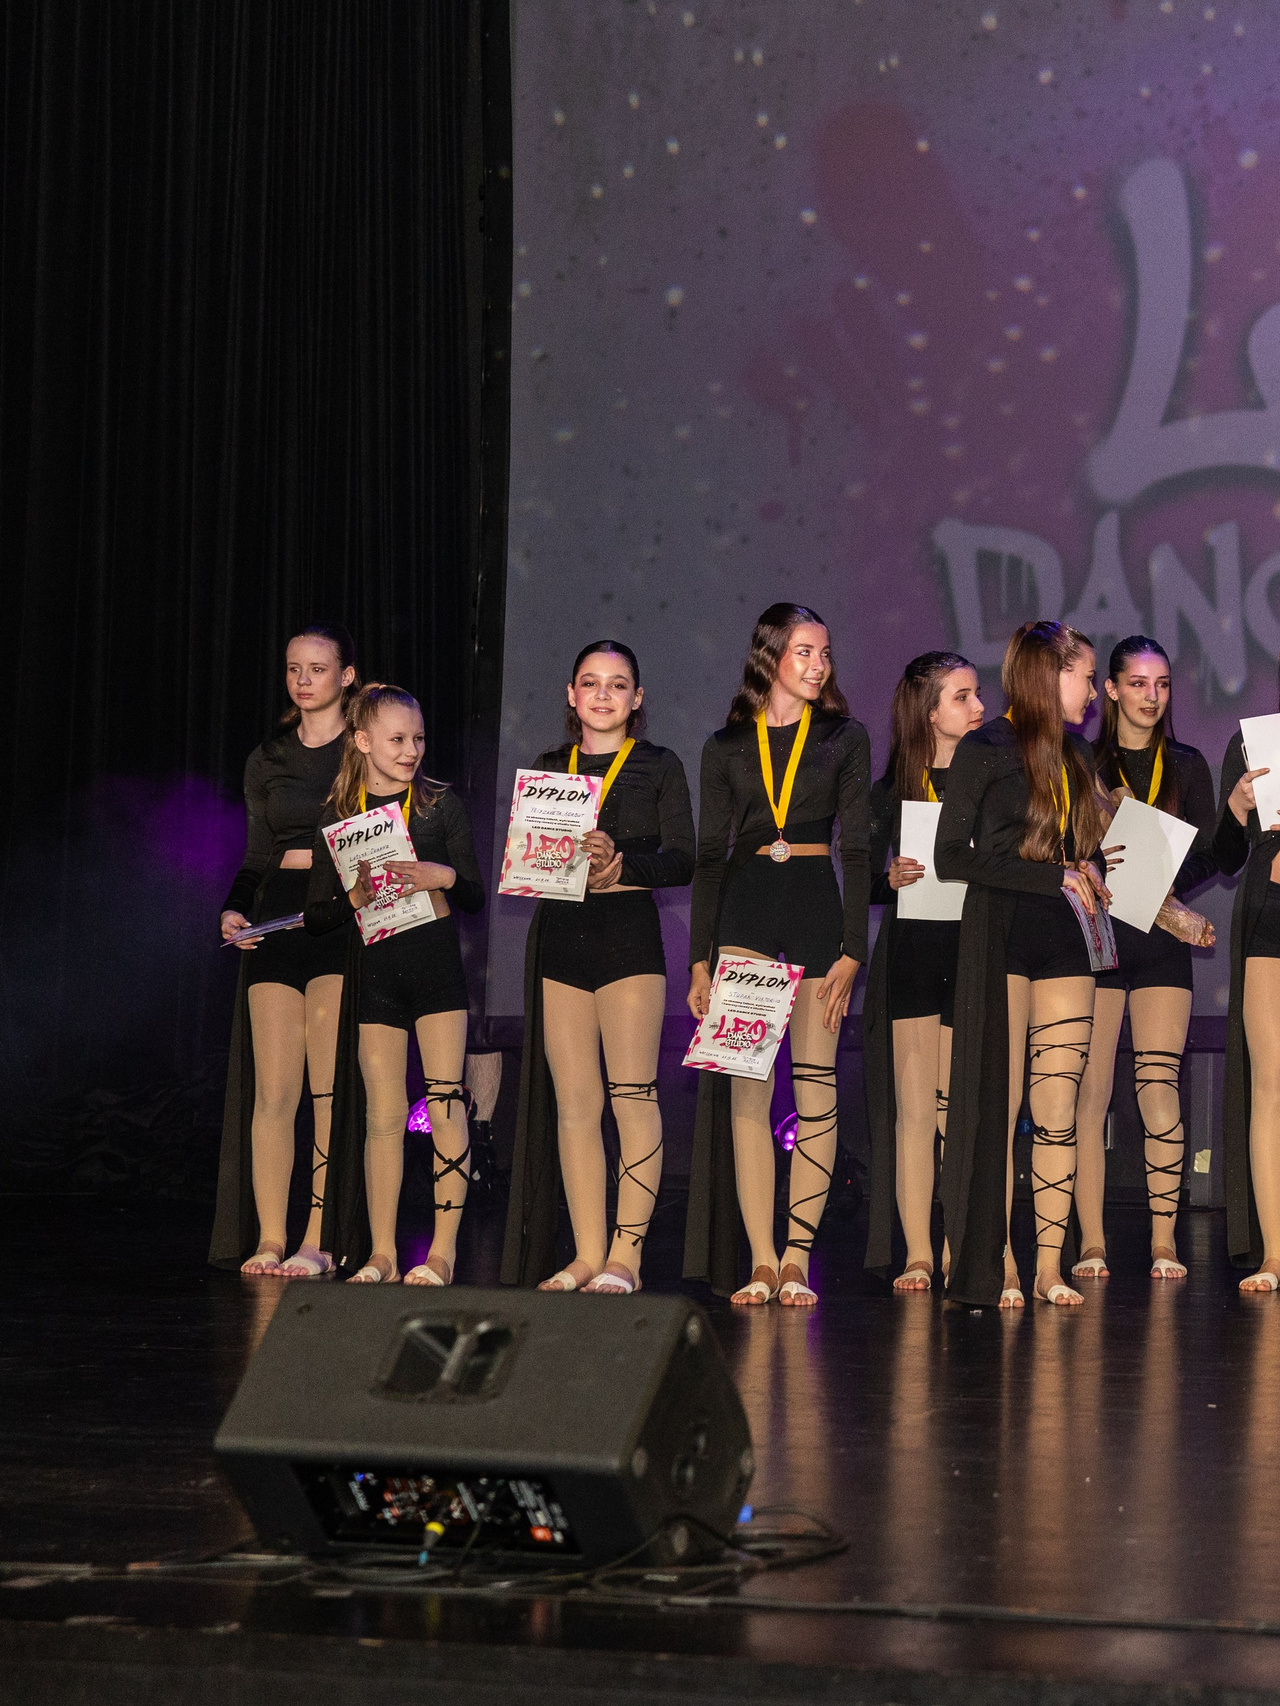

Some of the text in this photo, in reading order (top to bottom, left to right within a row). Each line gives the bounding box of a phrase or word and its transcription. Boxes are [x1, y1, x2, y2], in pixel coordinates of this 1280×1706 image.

[523, 786, 591, 805] DYPLOM
[336, 820, 394, 852] DYPLOM
[522, 832, 575, 863] LEO
[535, 859, 562, 869] STUDIO
[723, 970, 791, 992] DYPLOM
[712, 1014, 767, 1044] LEO
